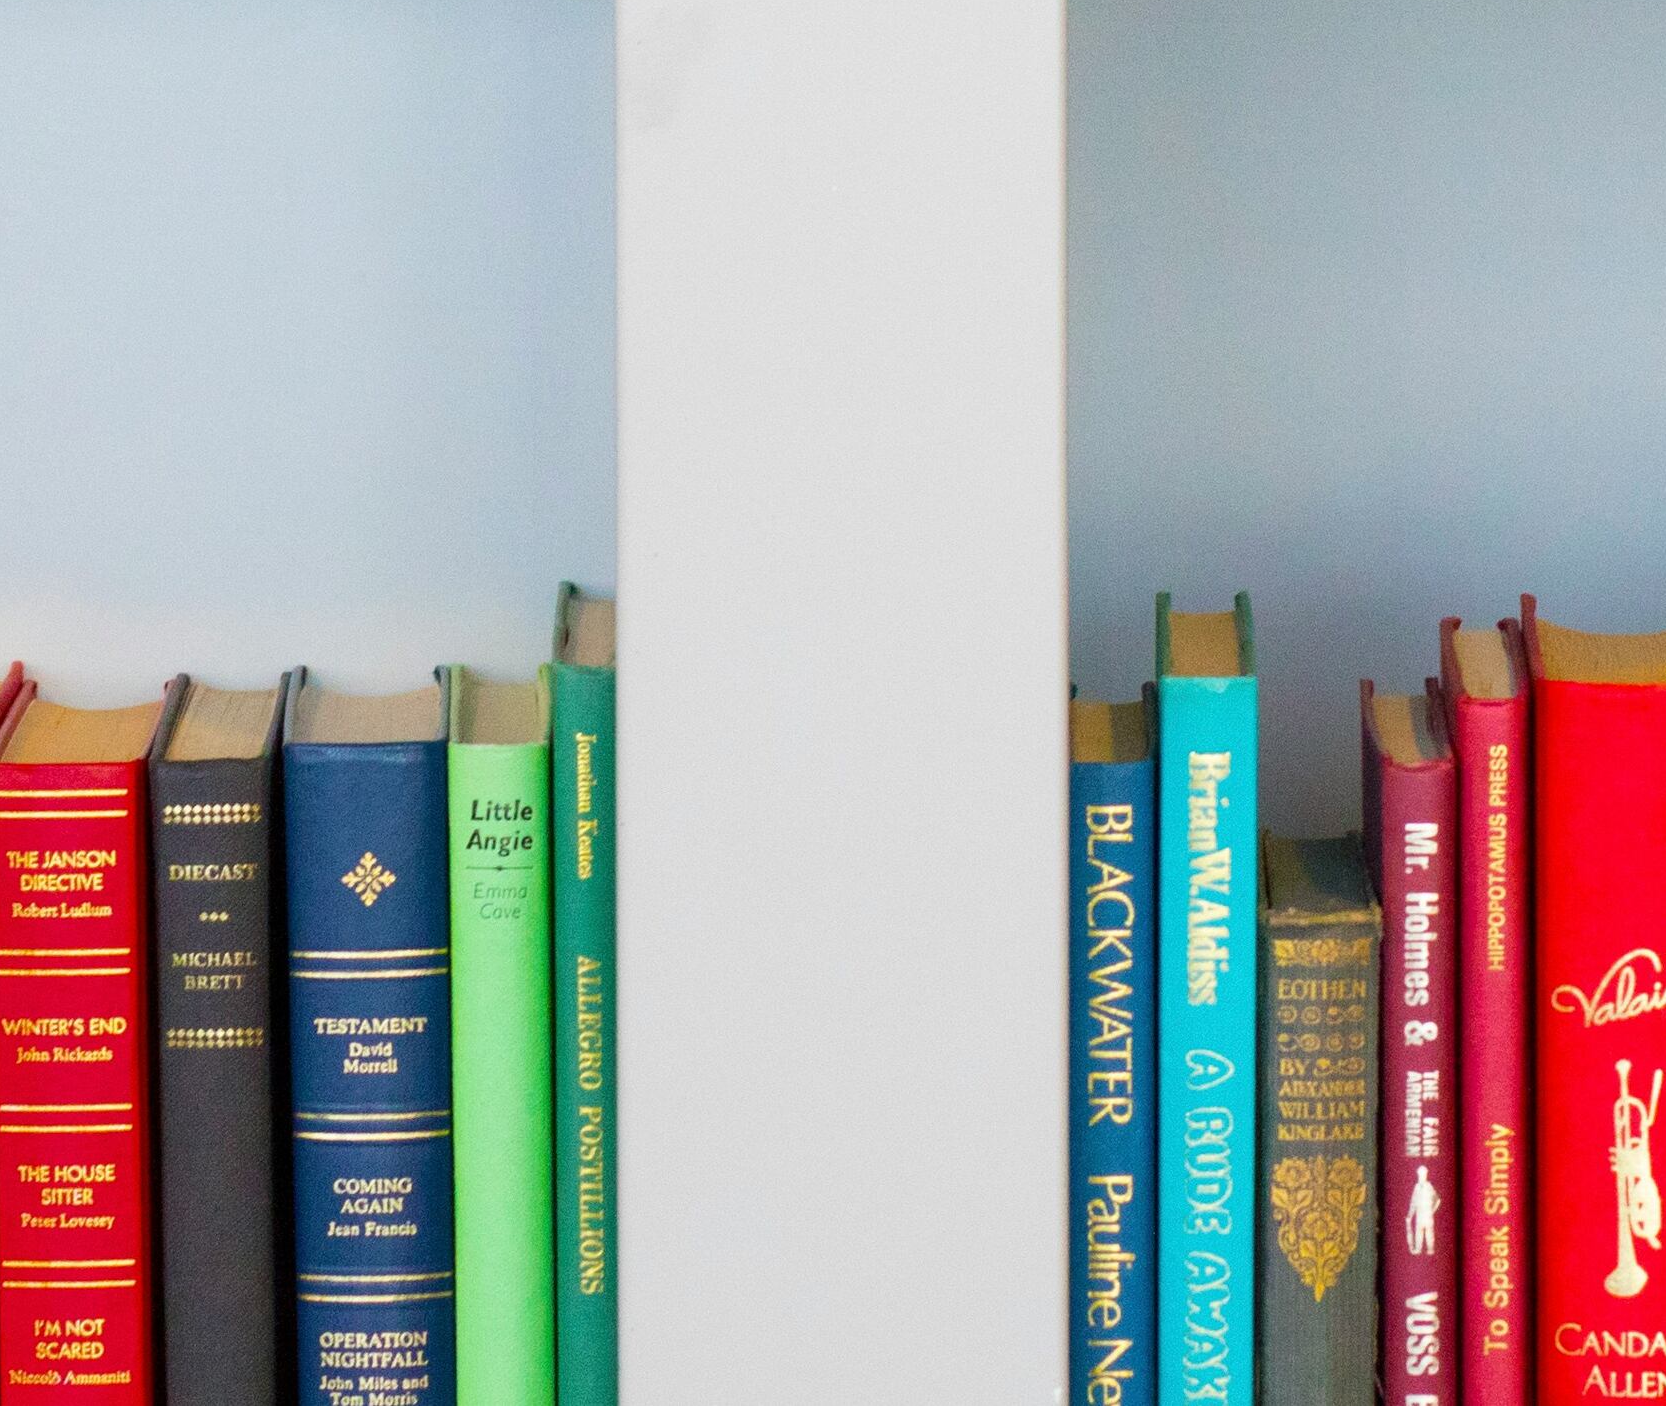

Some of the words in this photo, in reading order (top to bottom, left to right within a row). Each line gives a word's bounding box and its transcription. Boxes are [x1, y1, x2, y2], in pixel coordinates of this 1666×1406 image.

[1489, 744, 1508, 807] PRESS
[471, 799, 534, 822] Little
[7, 851, 38, 869] THE
[43, 851, 116, 868] JANSON
[466, 829, 534, 857] Angie
[1405, 822, 1438, 874] Mr.
[21, 873, 103, 891] DIRECTIVE
[1488, 814, 1507, 971] HIPPOPOTAMUS
[1087, 805, 1135, 1125] BLACKWATER
[1404, 892, 1439, 1006] Holmes
[2, 1018, 84, 1036] WINTER'S
[90, 1017, 126, 1035] END
[314, 1017, 427, 1035] TESTAMENT
[577, 956, 601, 1090] ALLEGRO
[18, 1166, 49, 1182] THE
[55, 1164, 115, 1182] HOUSE
[1485, 1123, 1513, 1215] Simply
[579, 1106, 603, 1294] POSTILLIONS
[1088, 1175, 1135, 1328] Pauline
[1484, 1225, 1513, 1308] Speak
[35, 1321, 61, 1336] I'M
[66, 1319, 104, 1336] NOT
[37, 1342, 104, 1359] SCARED
[1405, 1292, 1439, 1376] VOSS
[1484, 1319, 1509, 1355] To
